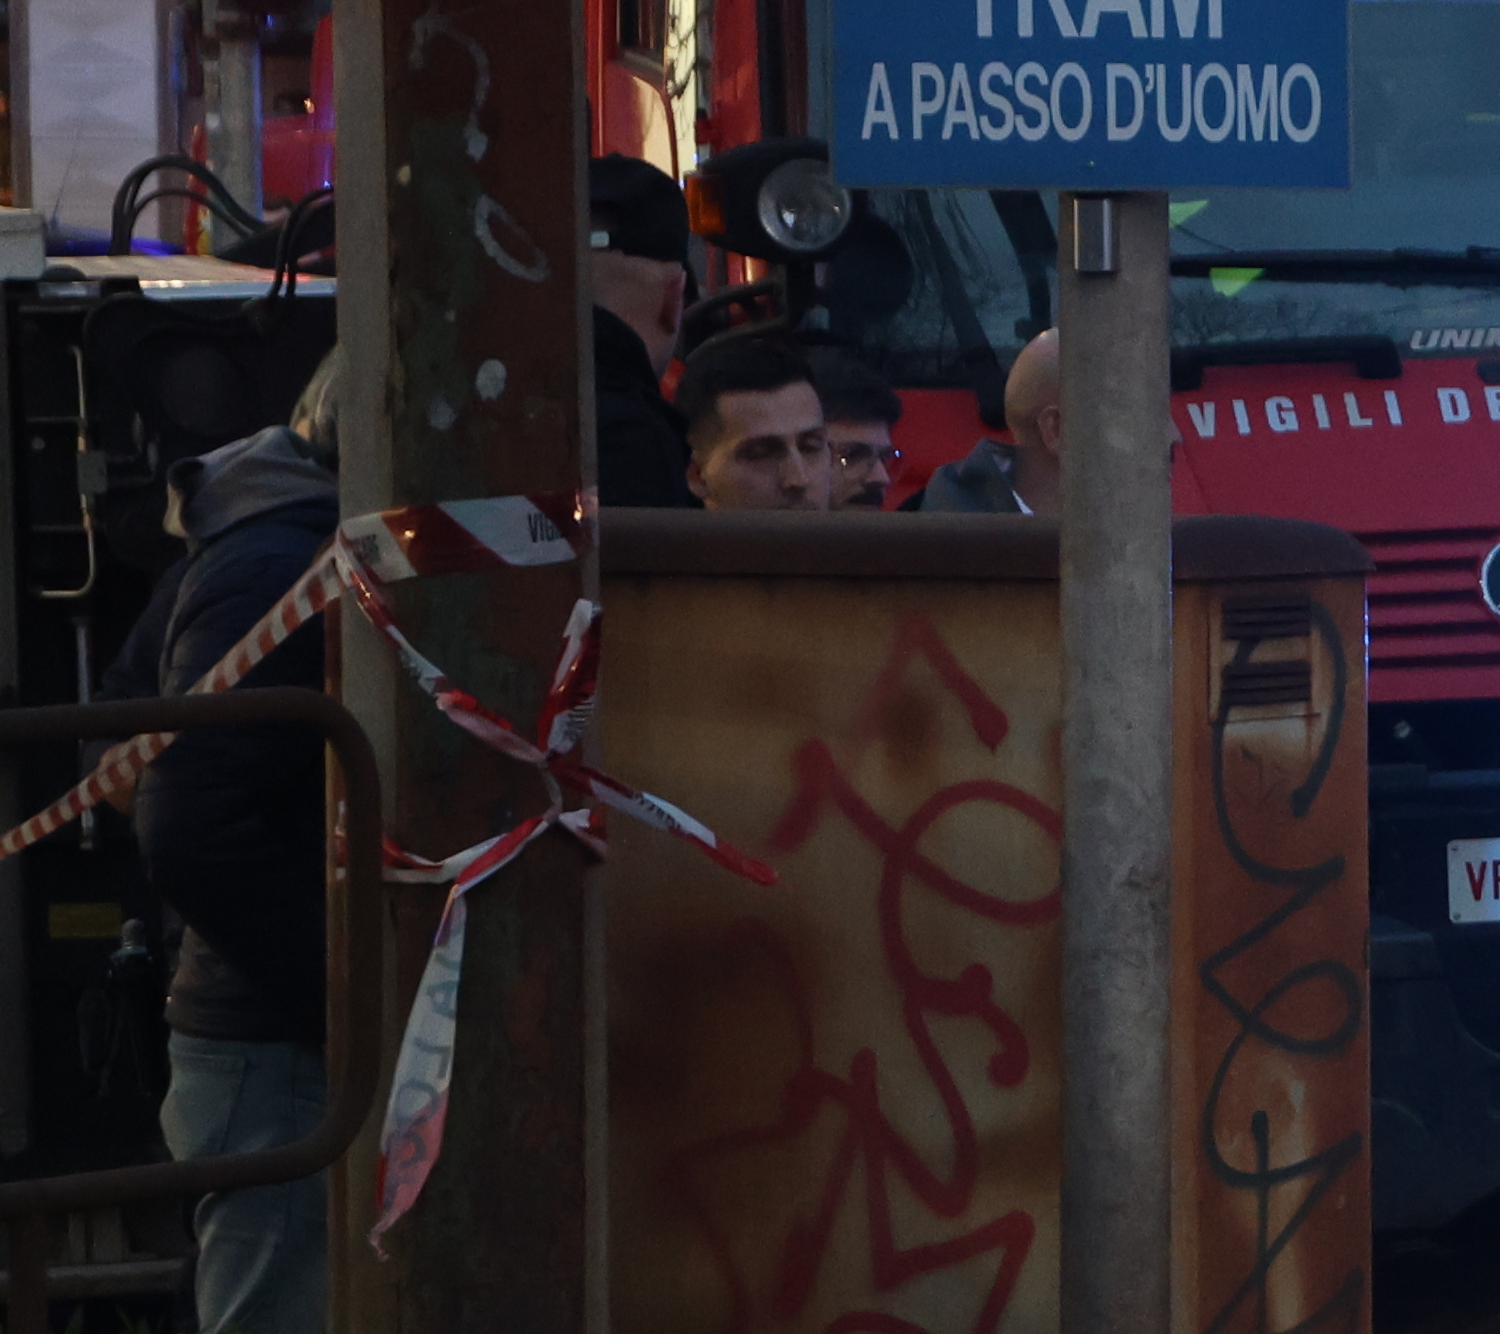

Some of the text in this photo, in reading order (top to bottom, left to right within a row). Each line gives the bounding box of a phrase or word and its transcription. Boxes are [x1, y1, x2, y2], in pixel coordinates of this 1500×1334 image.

[862, 61, 1322, 144] A PASSO D'UOMO
[1185, 389, 1402, 440] VIGILI
